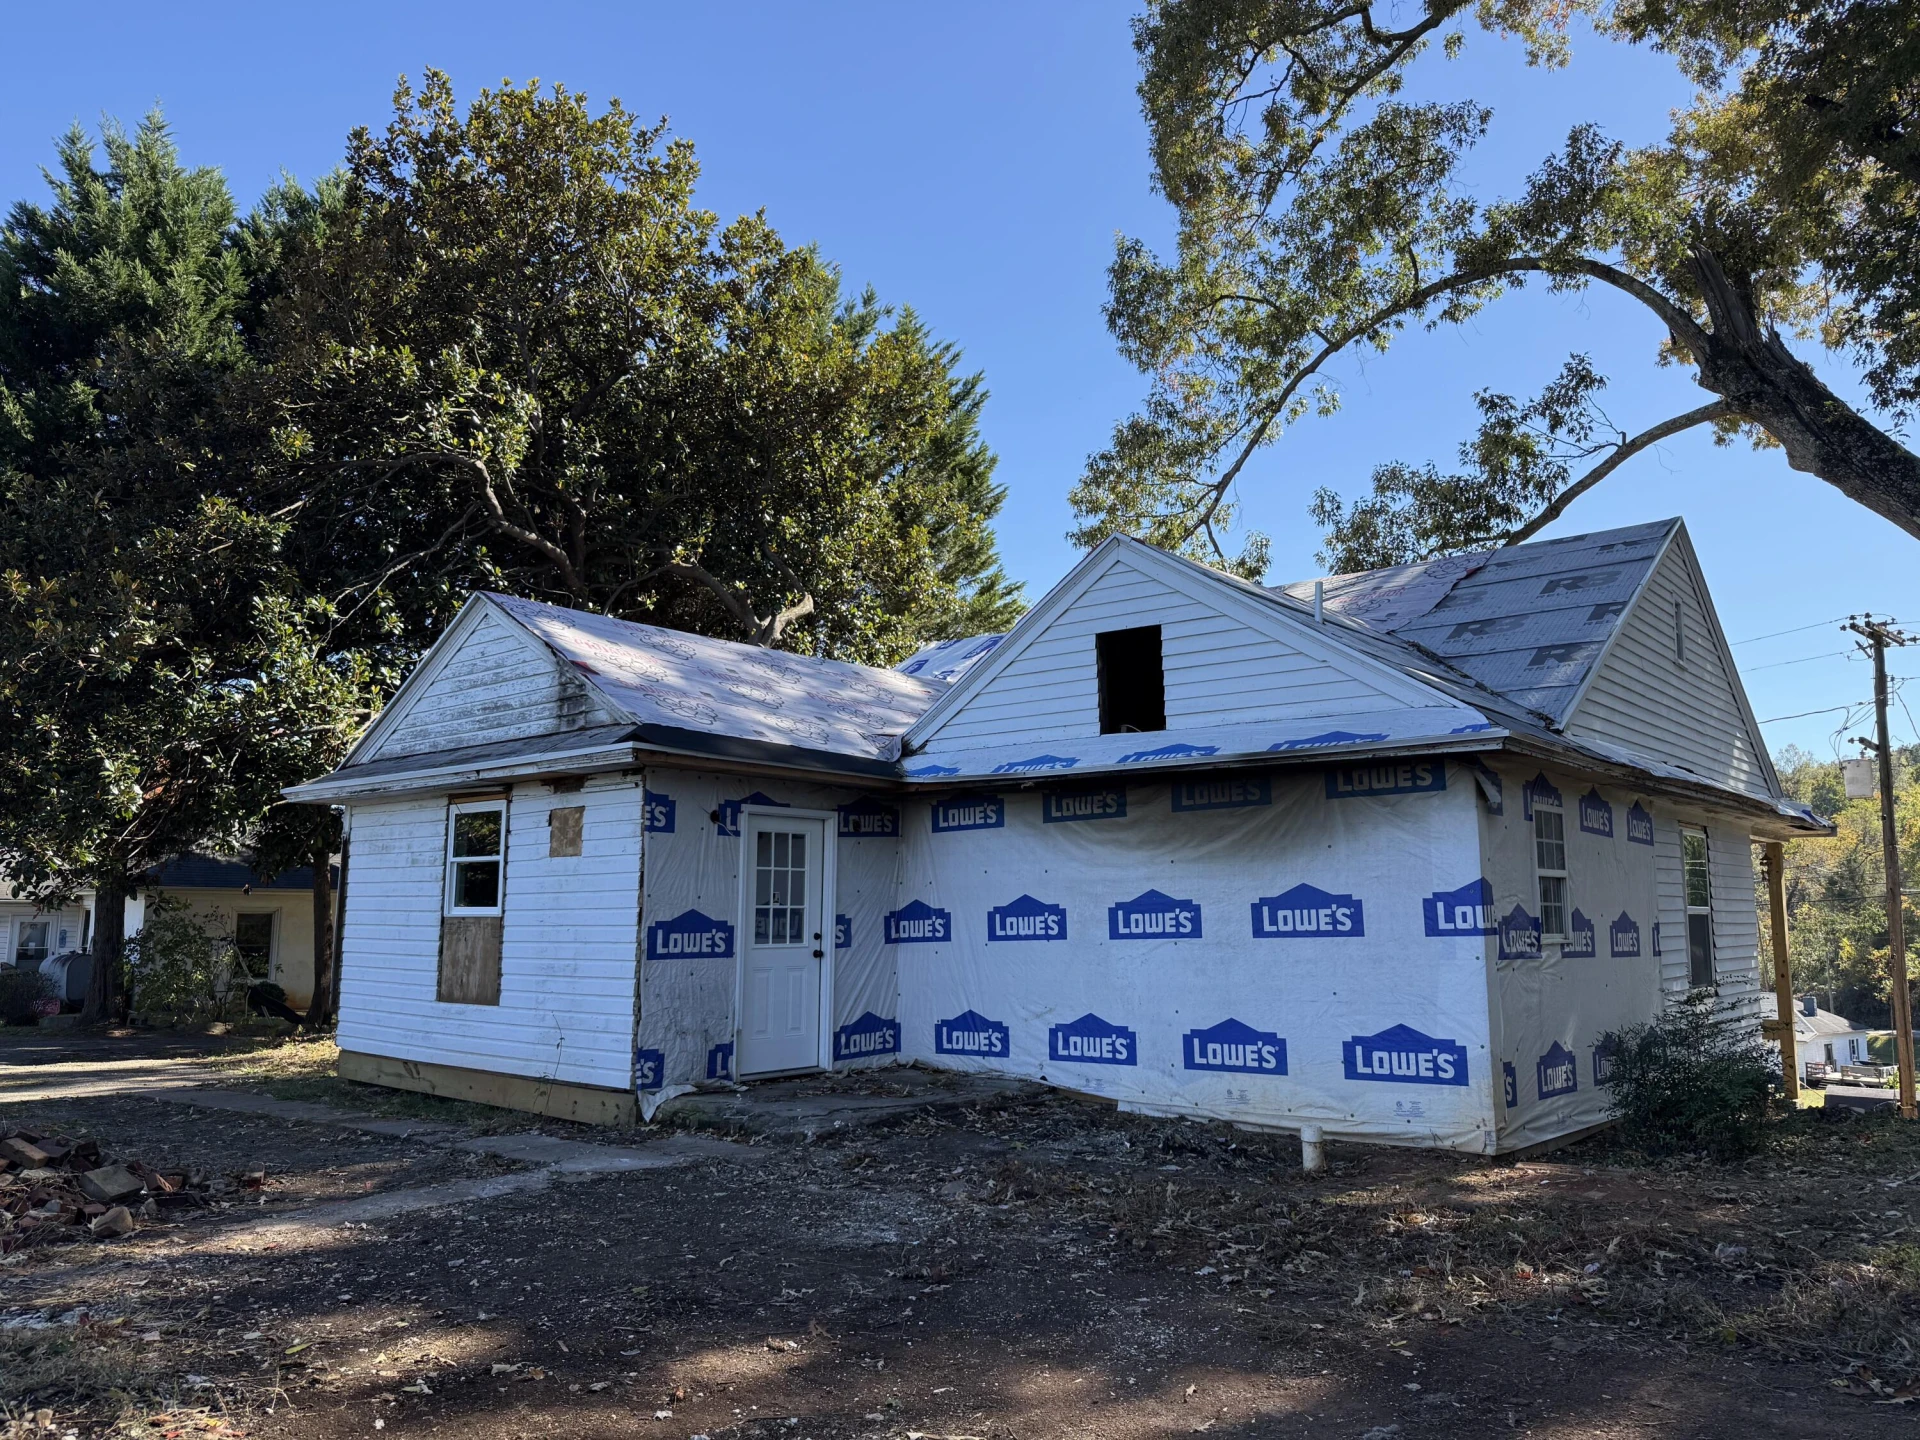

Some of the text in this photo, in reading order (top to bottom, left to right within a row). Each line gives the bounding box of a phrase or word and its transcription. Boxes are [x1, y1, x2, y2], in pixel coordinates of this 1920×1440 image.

[1586, 602, 1627, 622] R
[1337, 762, 1433, 792] LOWE'S
[1051, 791, 1117, 817] LOWE'S
[1181, 780, 1261, 806] LOWE'S
[939, 803, 997, 827] LOWE'S
[1582, 803, 1610, 832] LOWE'S
[1628, 814, 1651, 841] LOWE'S
[891, 916, 945, 939] LOWE'S
[995, 912, 1059, 936] LOWE'S
[1118, 908, 1192, 934] LOWE'S
[1262, 904, 1352, 932] LOWE'S
[657, 928, 727, 954] LOWE'S
[1502, 926, 1539, 953] LOWE'S
[1612, 928, 1638, 952] LOWE'S
[840, 1027, 895, 1055] LOWE'S
[942, 1028, 1002, 1052] LOWE'S
[1057, 1031, 1127, 1060] LOWE'S
[1194, 1037, 1277, 1069] LOWE'S
[1355, 1045, 1455, 1078] LOWE'S
[1541, 1061, 1574, 1093] LOWE'S
